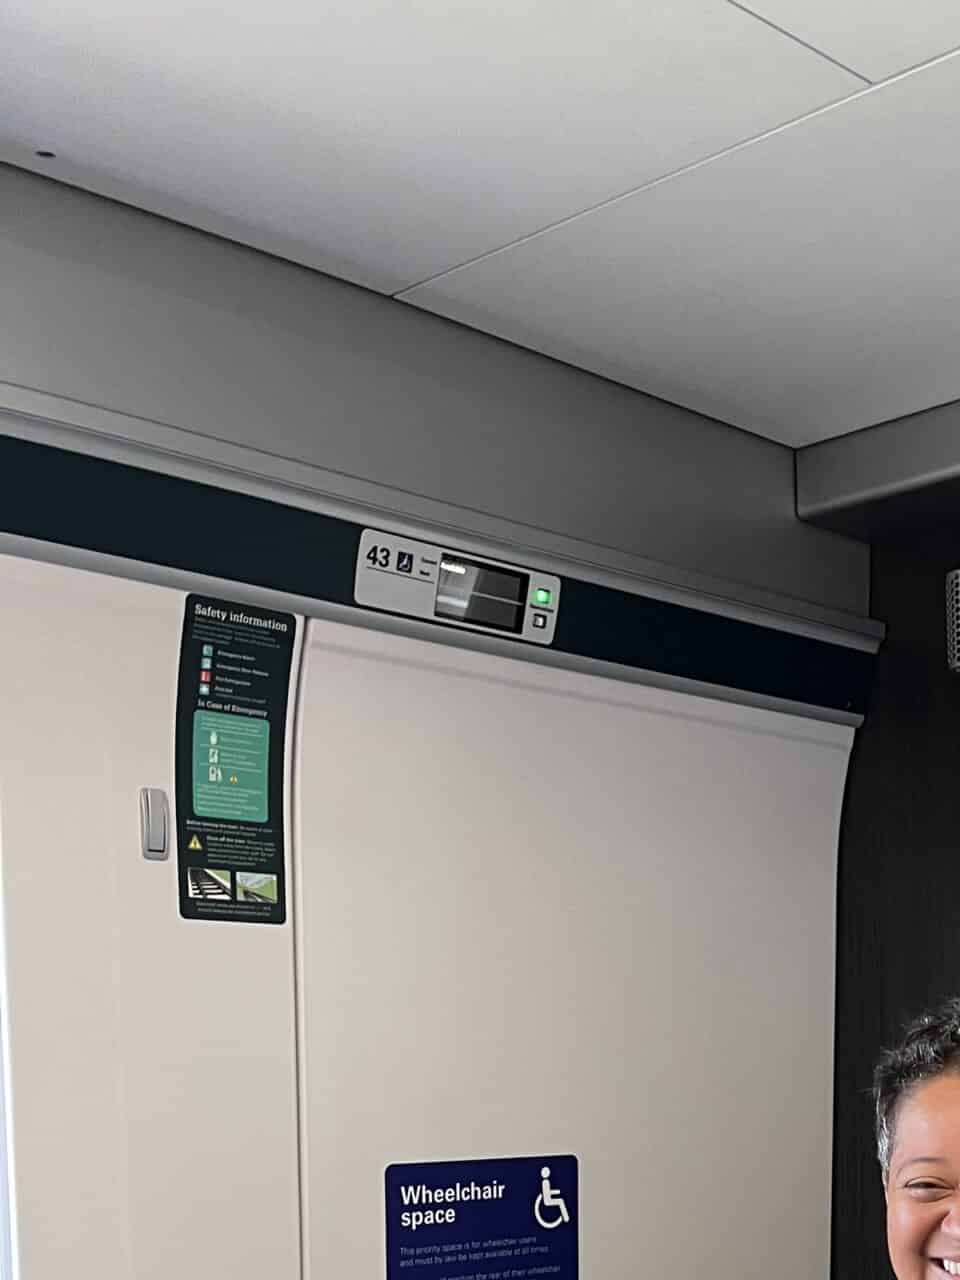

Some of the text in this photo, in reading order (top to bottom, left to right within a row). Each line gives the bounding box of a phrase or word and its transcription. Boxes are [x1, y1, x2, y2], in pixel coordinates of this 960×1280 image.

[366, 545, 391, 568] 43
[194, 603, 228, 621] Safety
[229, 611, 288, 632] information
[400, 1180, 505, 1206] Wheelchair
[400, 1208, 456, 1231] space
